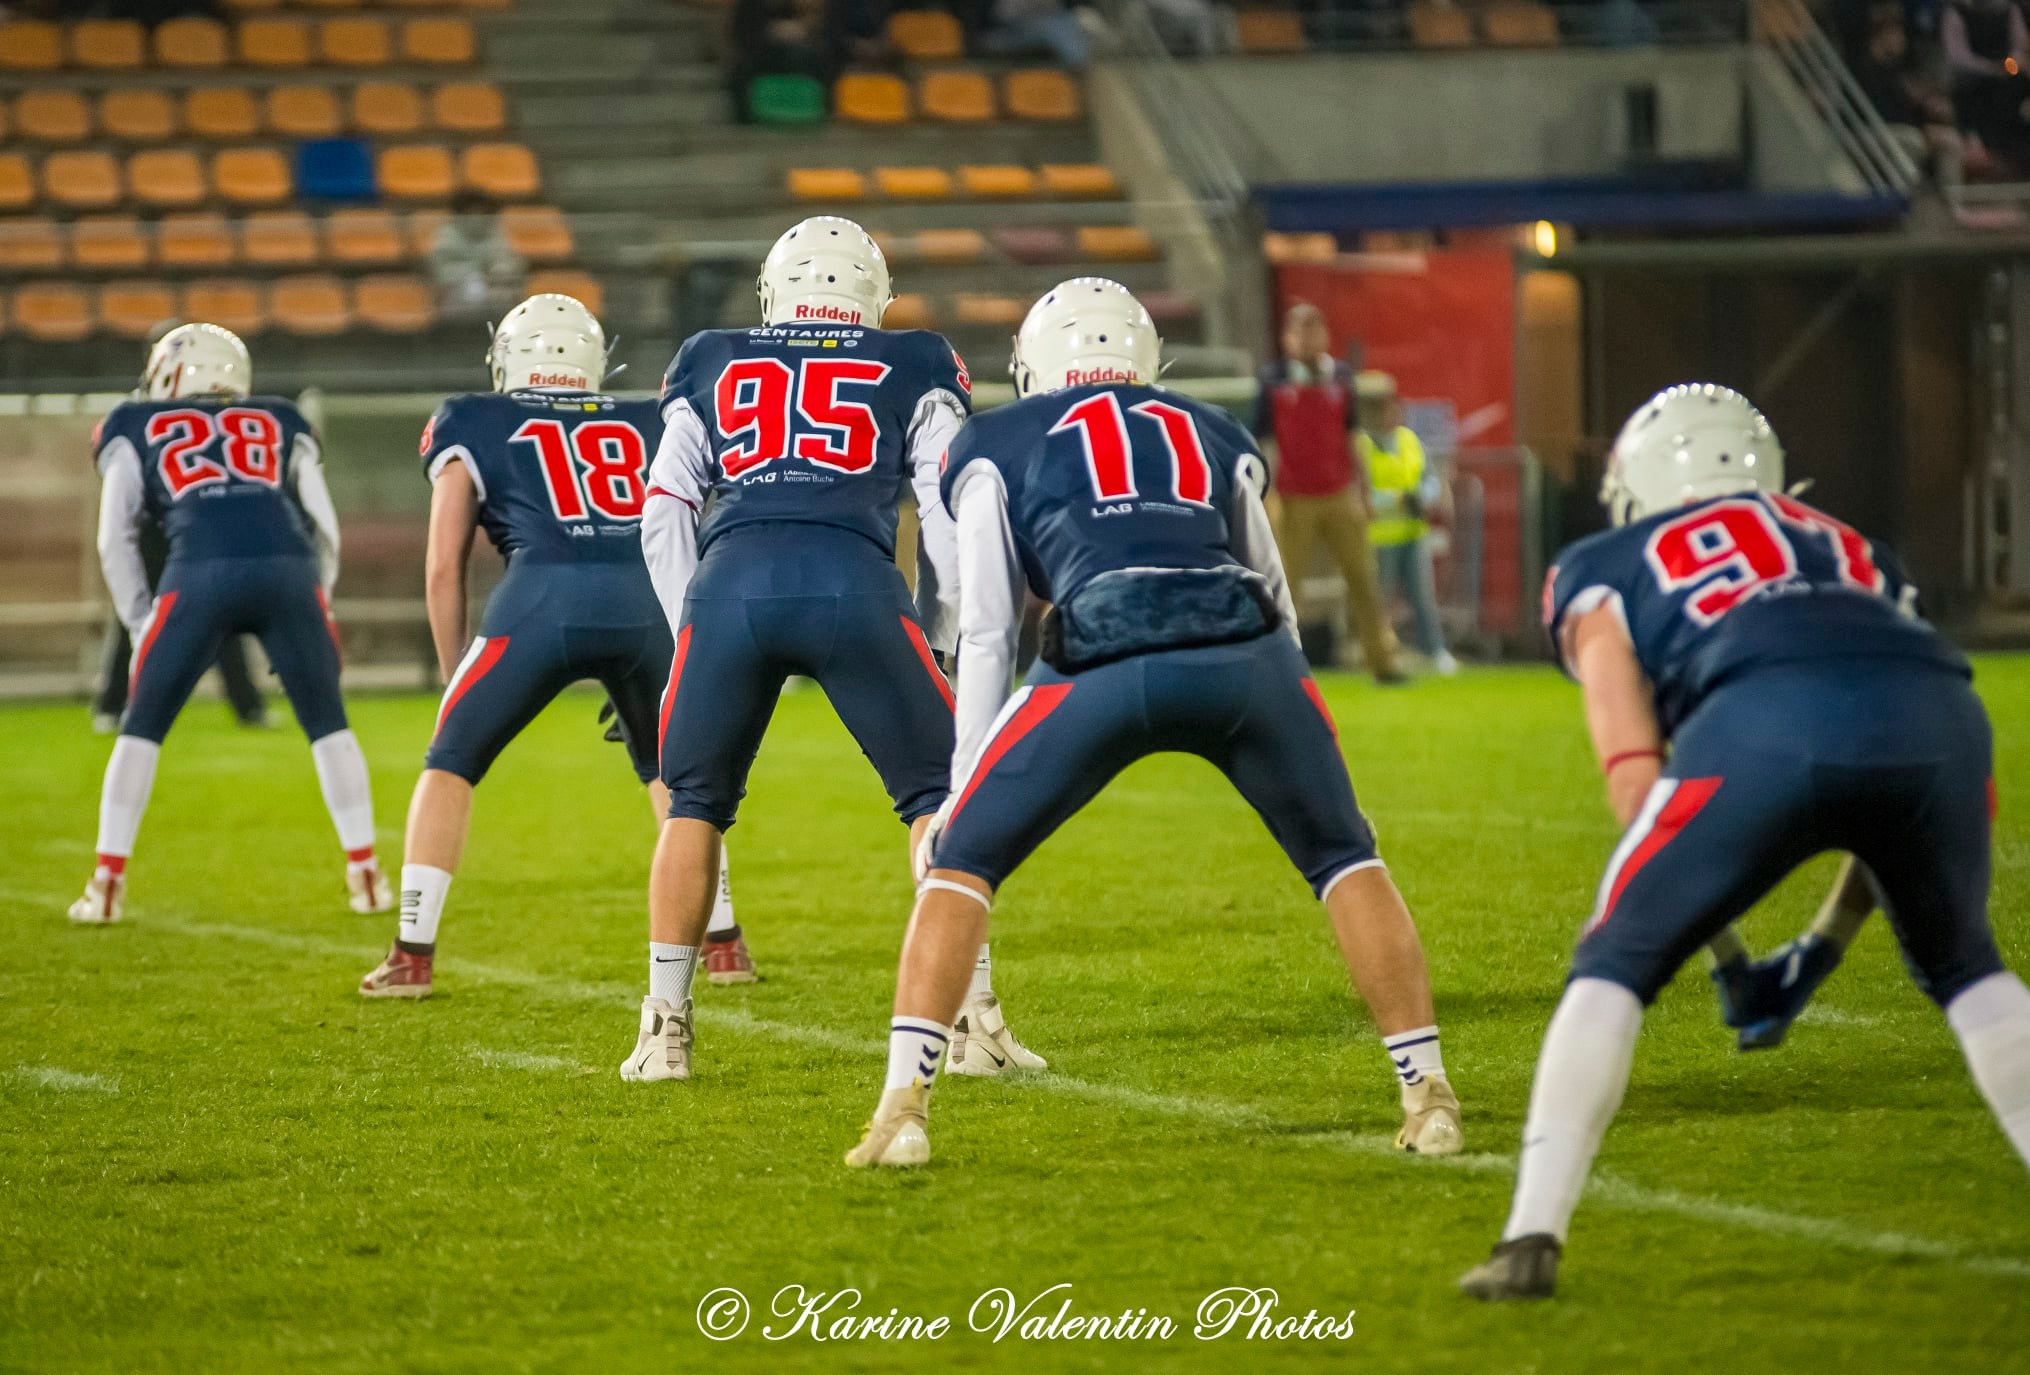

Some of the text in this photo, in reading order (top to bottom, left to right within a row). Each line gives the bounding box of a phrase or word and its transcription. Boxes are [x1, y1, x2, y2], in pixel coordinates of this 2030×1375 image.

[749, 328, 864, 338] CENTAURES
[796, 305, 861, 325] Riddell
[529, 373, 587, 389] Riddell
[1066, 367, 1138, 387] Riddell
[714, 357, 893, 481] 95
[144, 407, 282, 501] 28
[507, 418, 648, 522] 18
[1046, 391, 1215, 510] 11
[1091, 503, 1133, 517] LAB
[1645, 492, 1884, 628] 97
